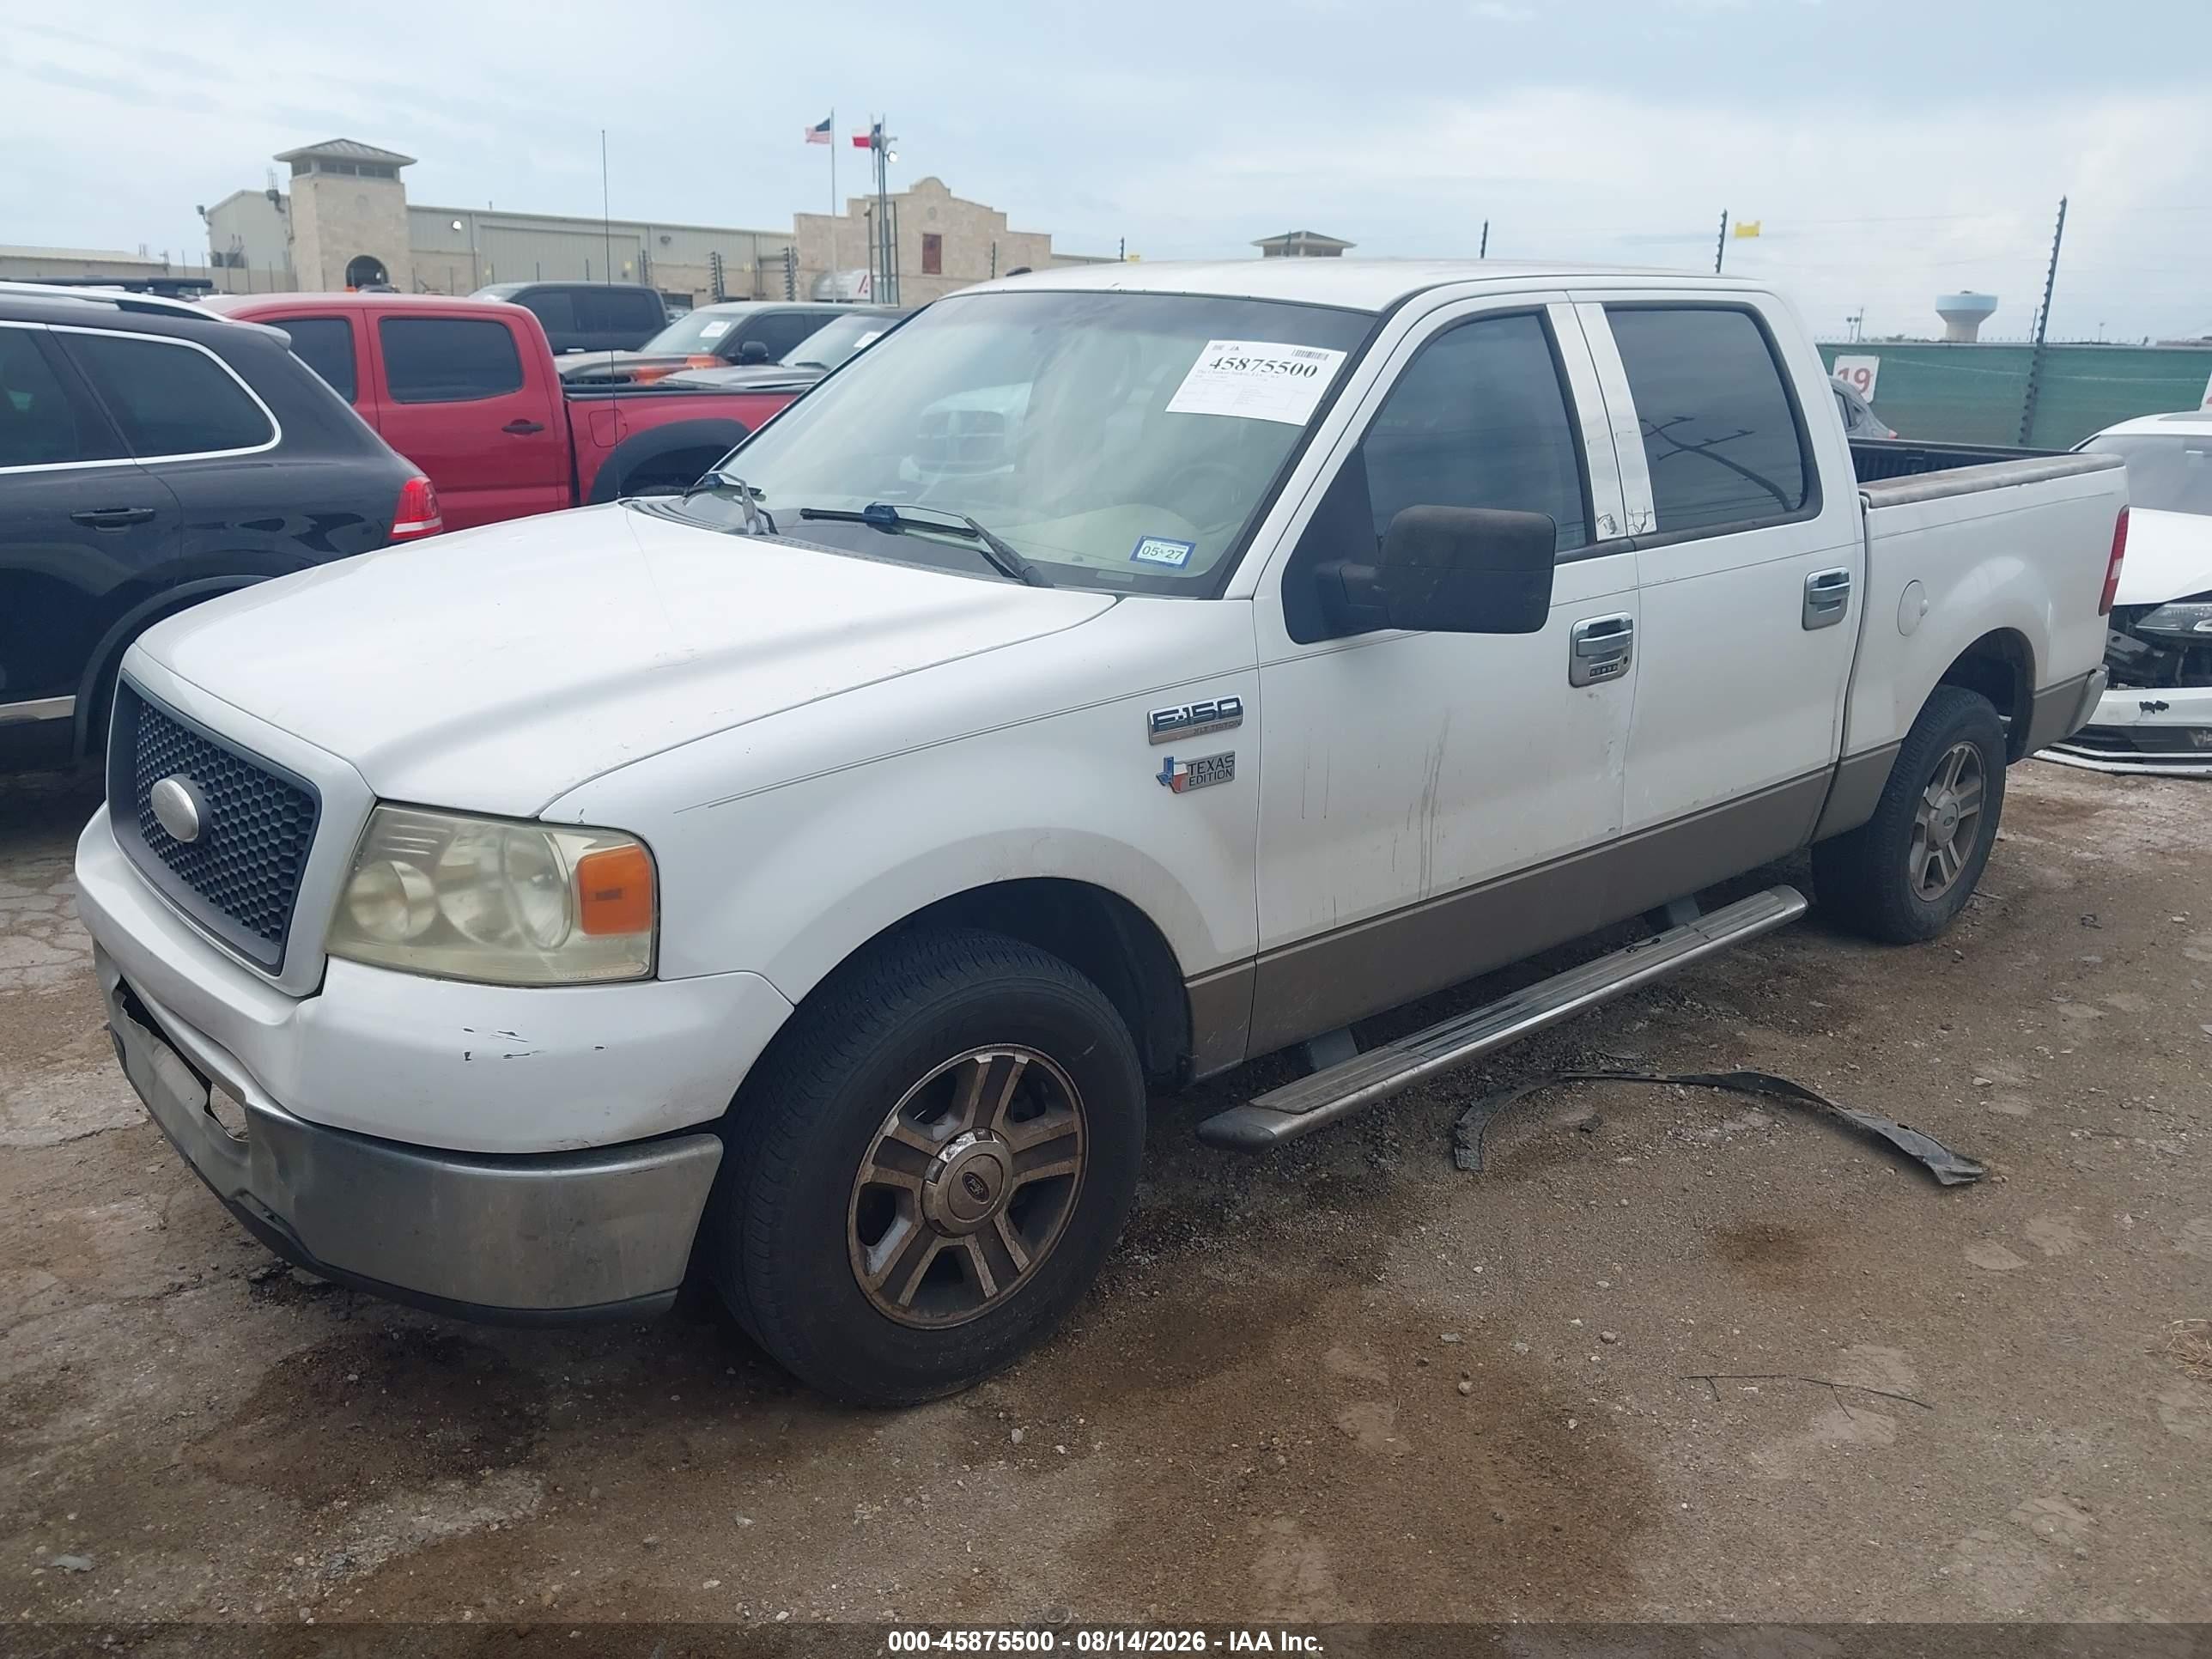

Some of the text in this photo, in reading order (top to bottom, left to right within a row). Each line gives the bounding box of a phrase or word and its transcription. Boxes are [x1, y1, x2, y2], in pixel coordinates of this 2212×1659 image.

[1209, 357, 1318, 378] 45875500
[1142, 545, 1184, 560] 05 27
[1188, 755, 1234, 775] TEXAS
[1188, 768, 1233, 787] EDITION
